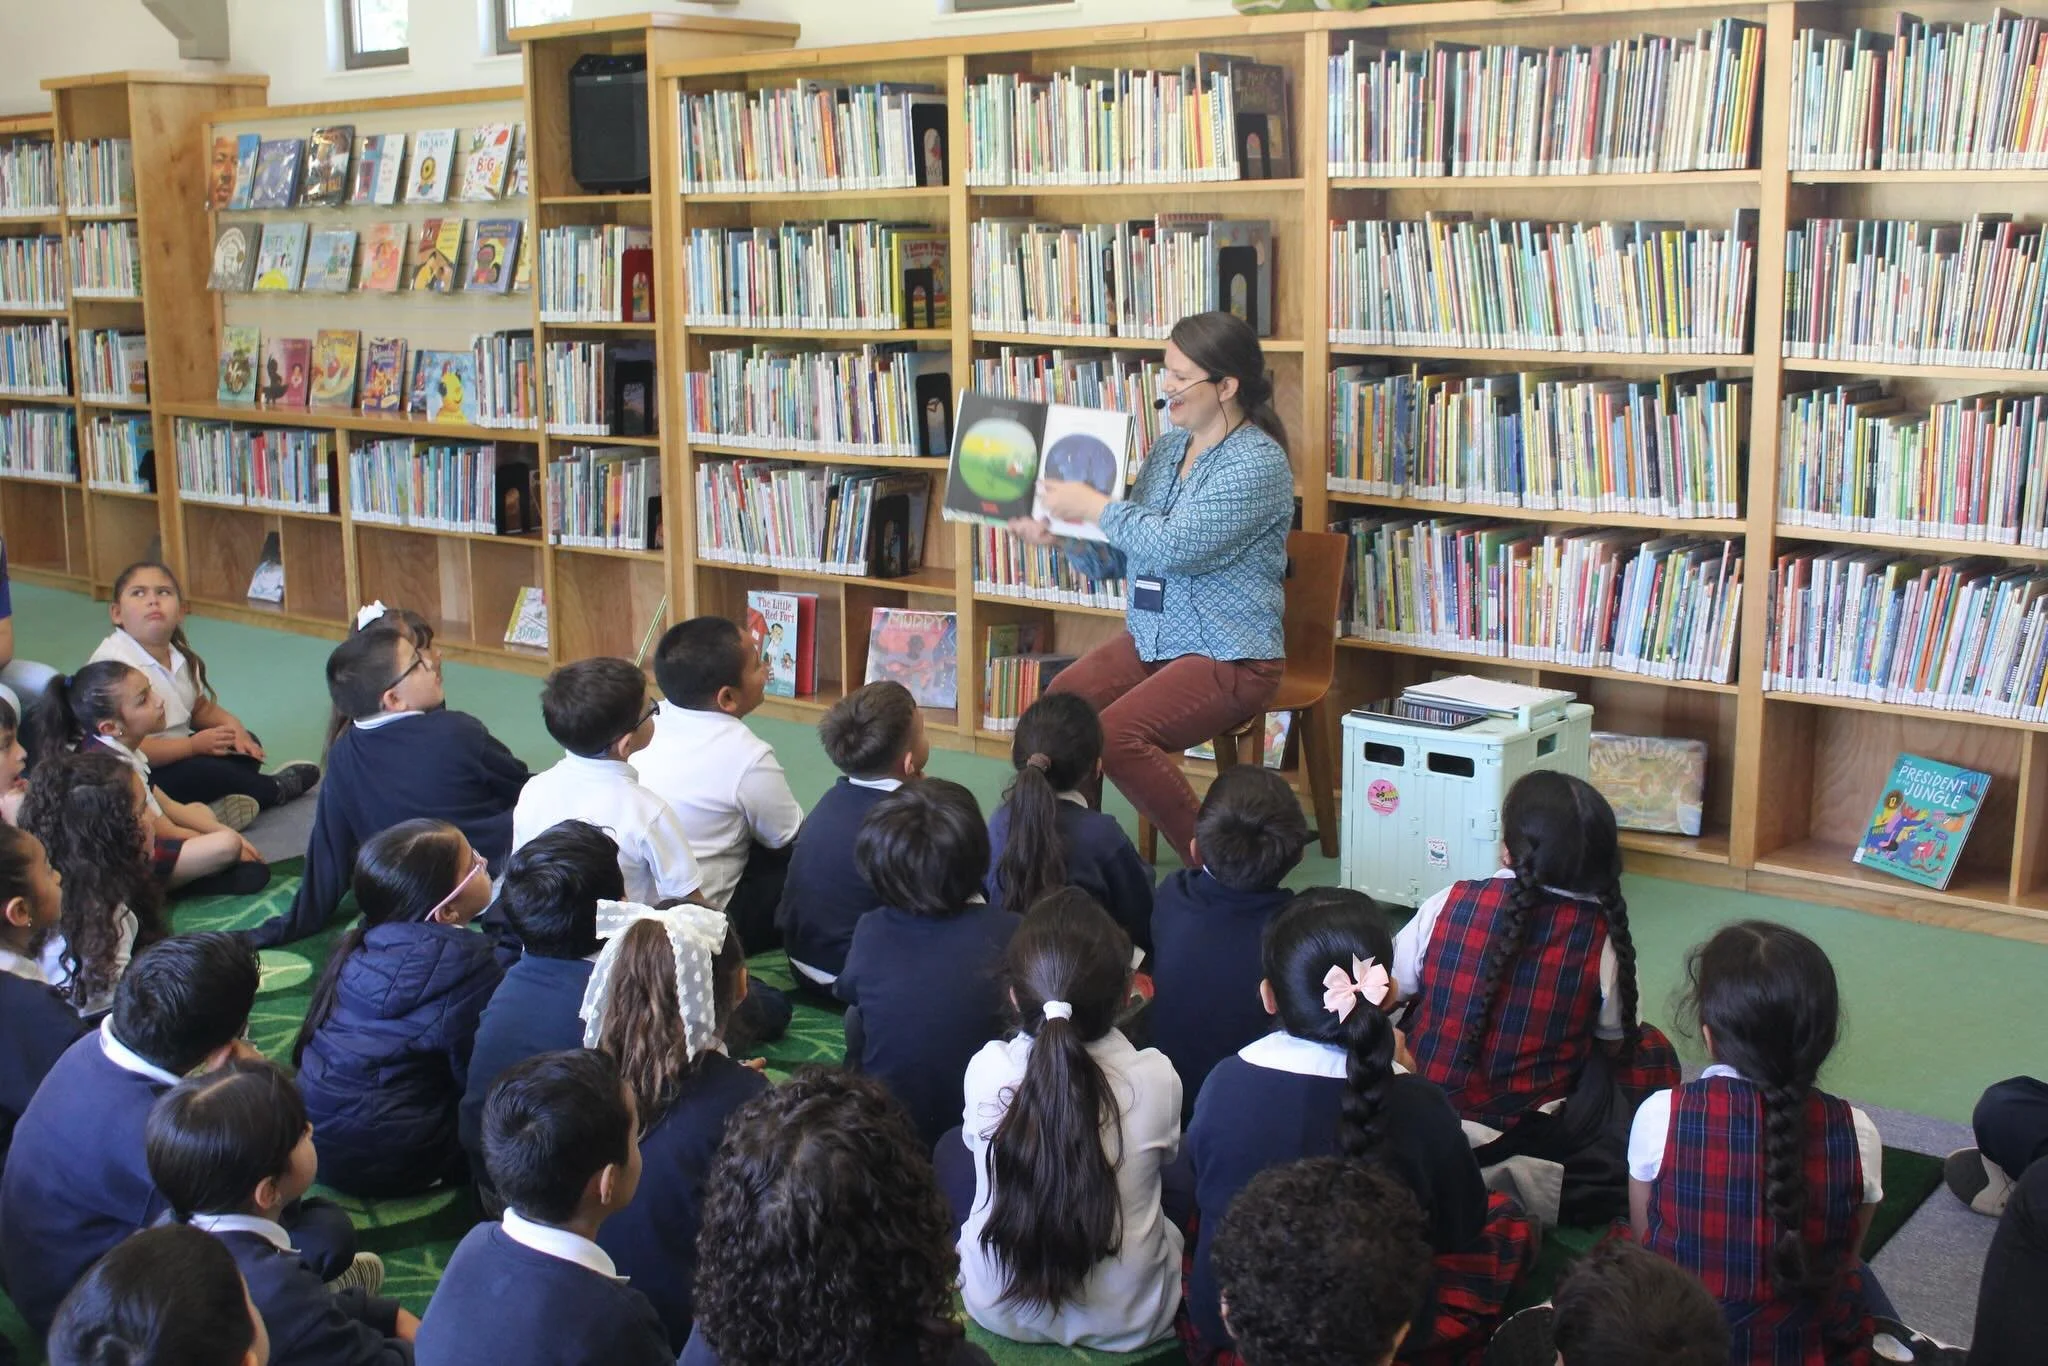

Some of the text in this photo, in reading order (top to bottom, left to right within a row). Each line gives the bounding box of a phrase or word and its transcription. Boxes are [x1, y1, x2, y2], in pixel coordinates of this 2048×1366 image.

[757, 596, 792, 611] The Little
[765, 609, 795, 624] Red Fort
[1904, 783, 1961, 809] JUNGLE
